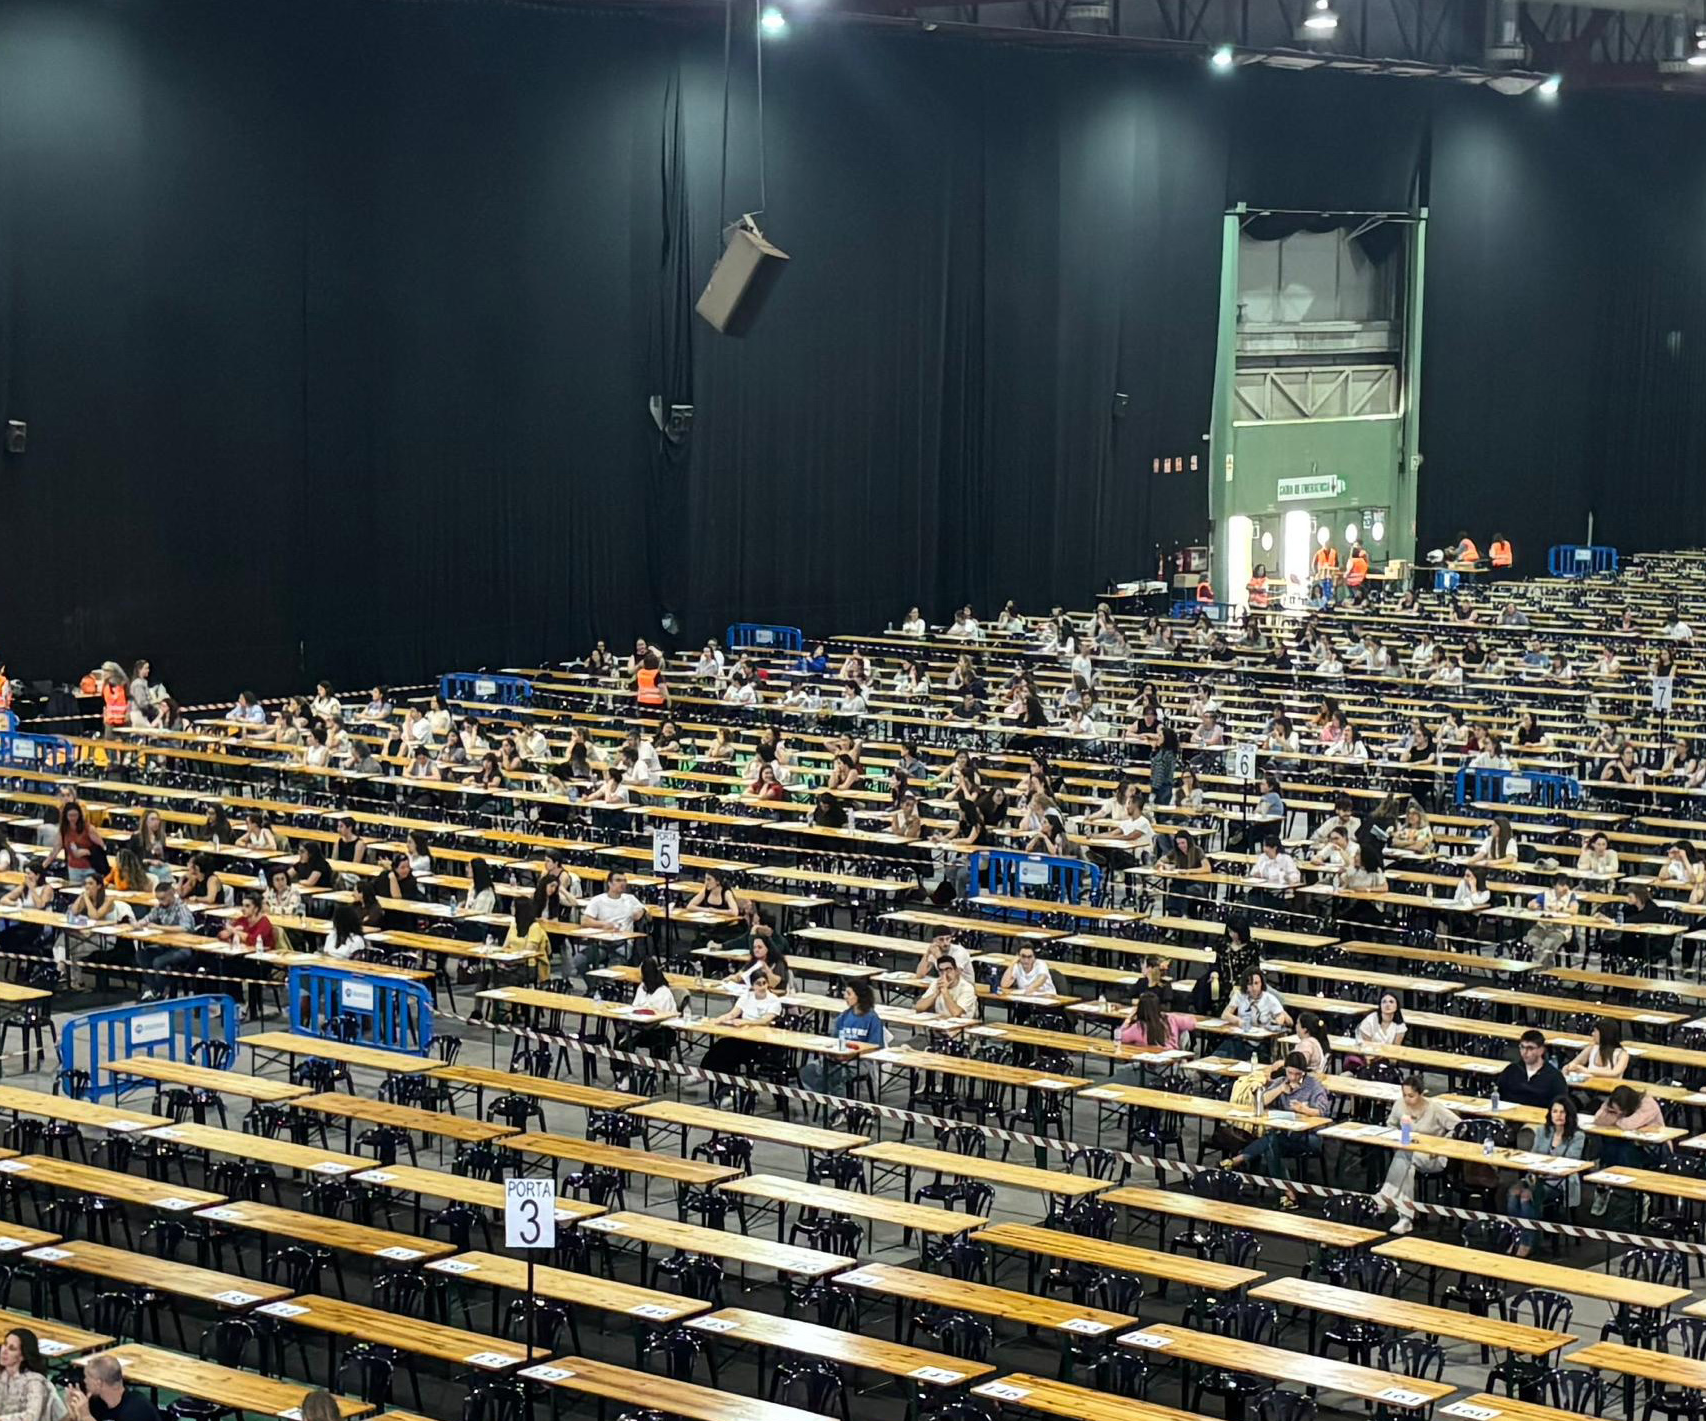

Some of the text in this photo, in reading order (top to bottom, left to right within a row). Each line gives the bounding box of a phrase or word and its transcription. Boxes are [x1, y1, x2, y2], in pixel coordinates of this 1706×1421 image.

[1658, 686, 1667, 707] 7
[1240, 754, 1250, 776] 6
[660, 844, 671, 868] 5
[508, 1182, 552, 1197] PORTA
[520, 1200, 541, 1245] 3
